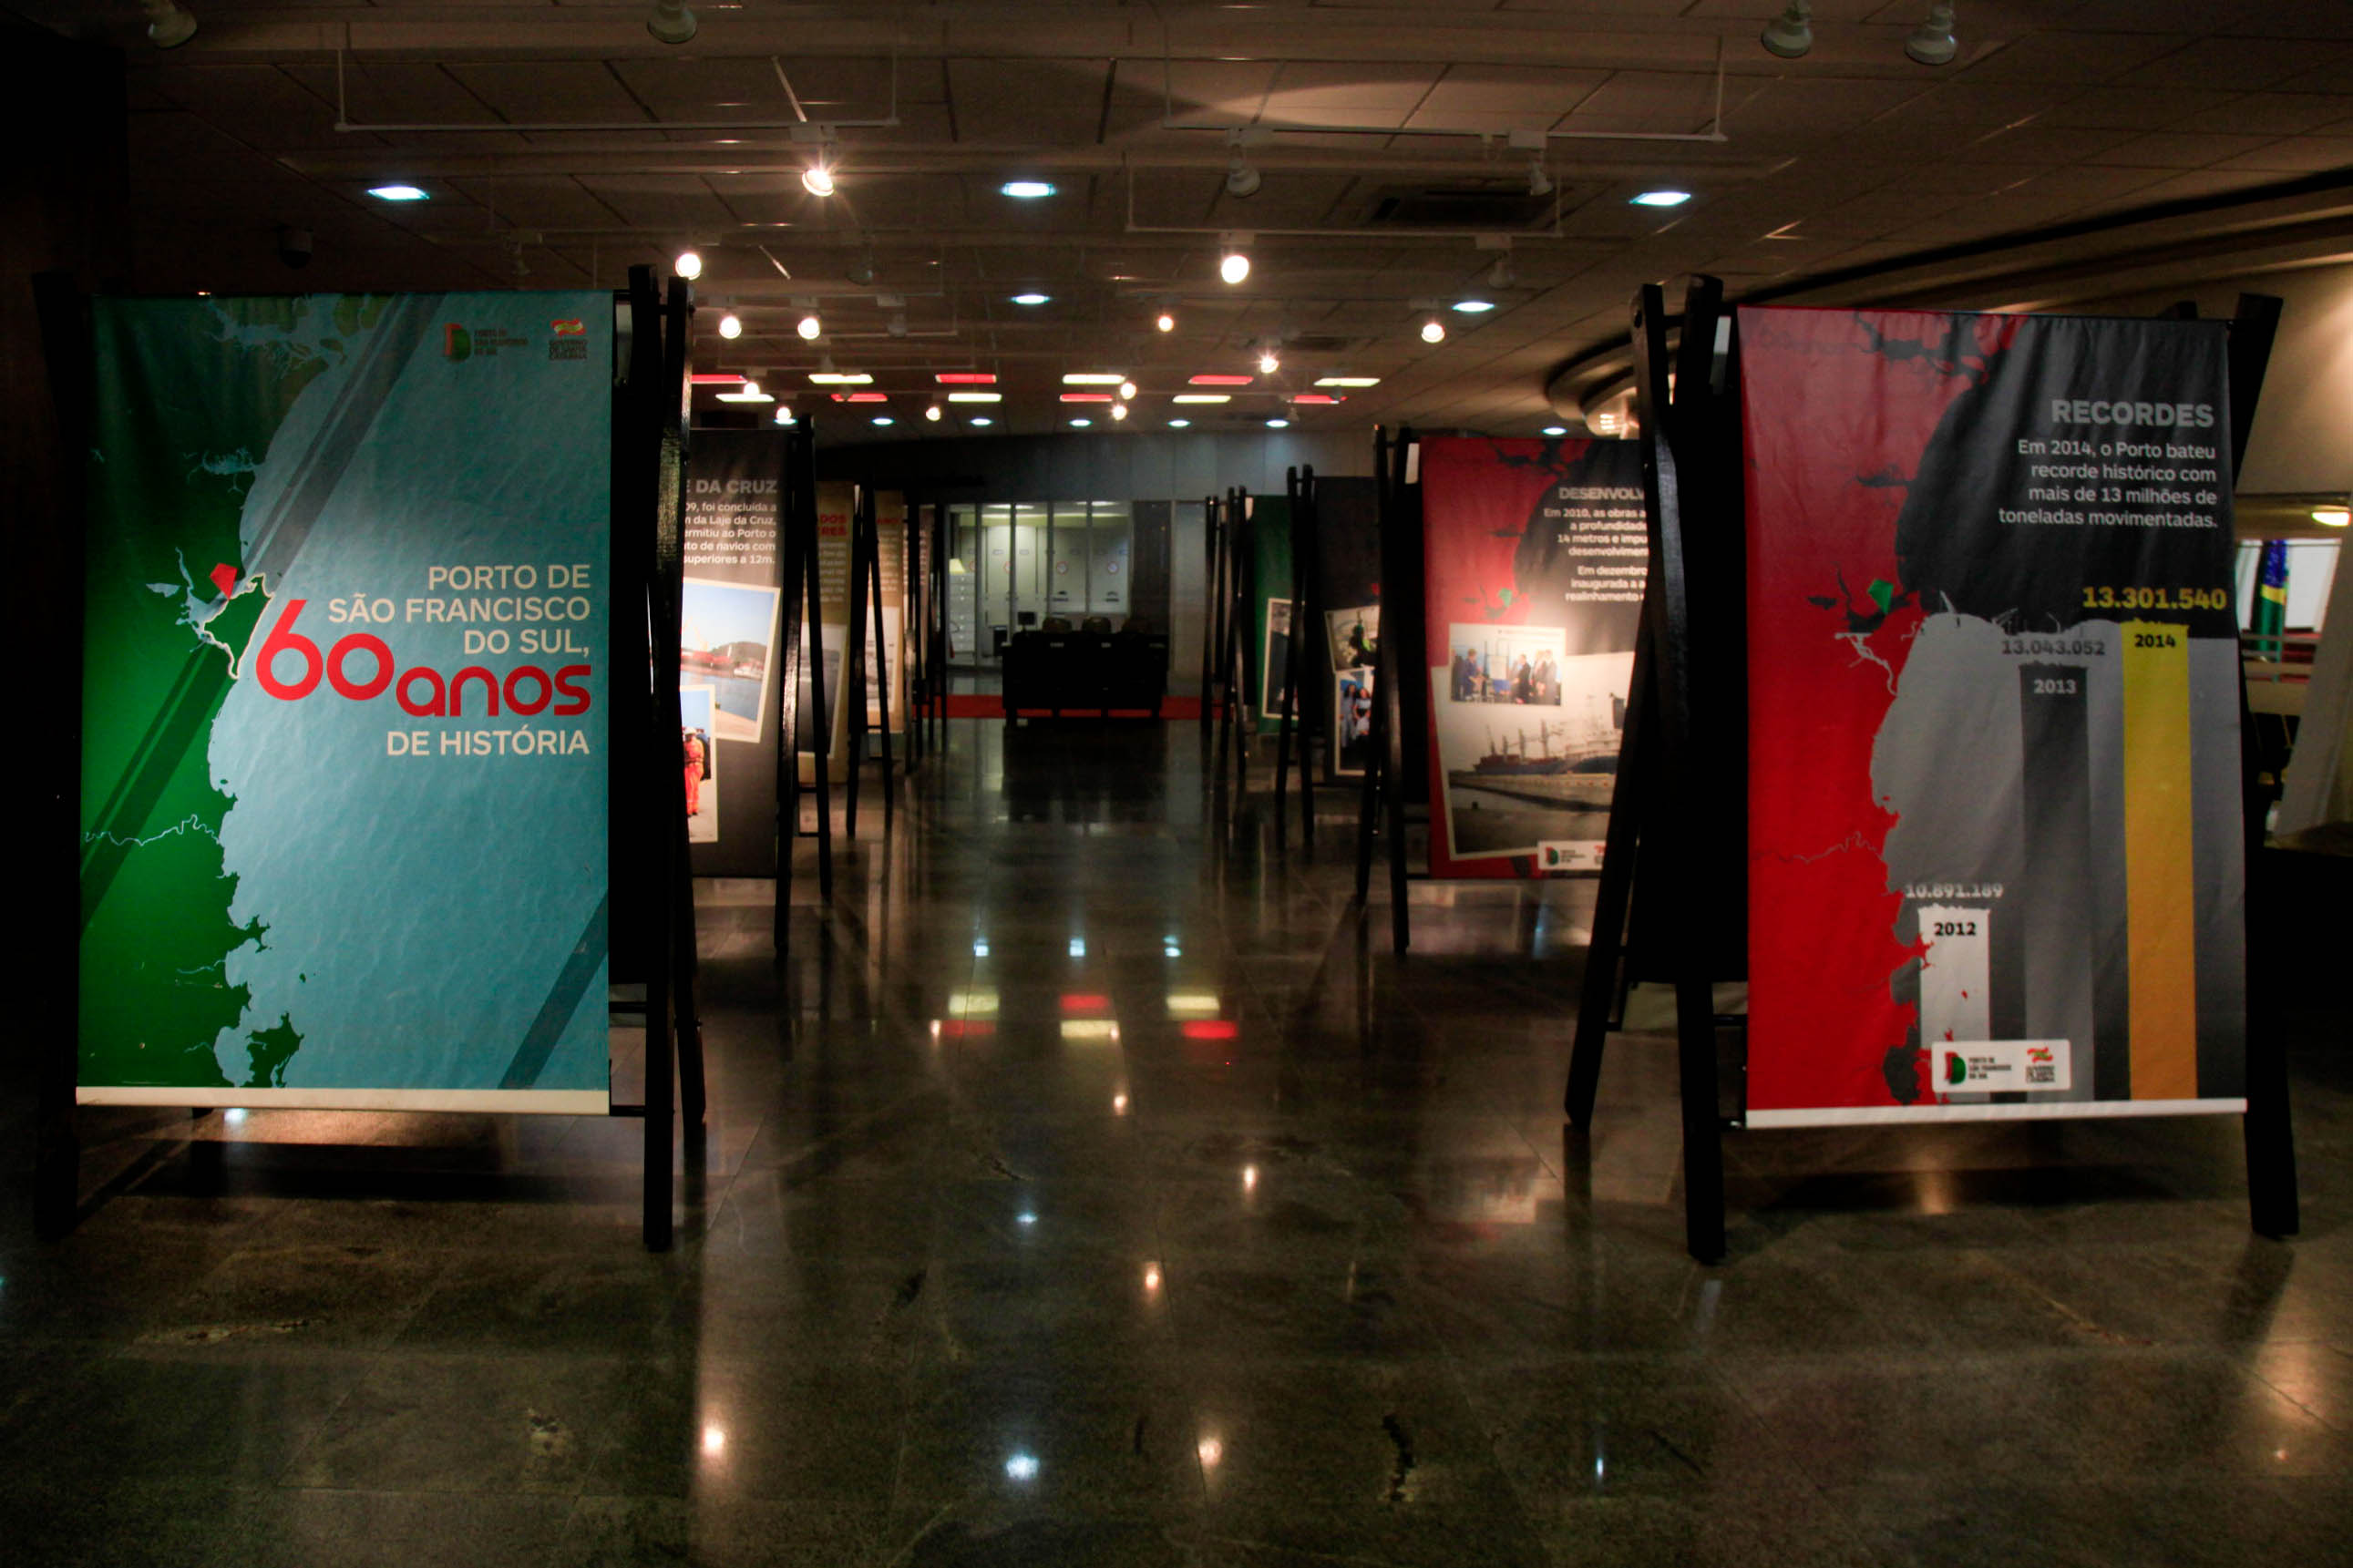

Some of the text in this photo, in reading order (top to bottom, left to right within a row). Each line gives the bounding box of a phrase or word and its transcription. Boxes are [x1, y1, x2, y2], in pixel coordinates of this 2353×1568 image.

[2050, 399, 2215, 428] RECORDES
[2017, 439, 2216, 459] Em 2014, o Porto bateu
[2030, 463, 2217, 482] recorde histórico com
[695, 479, 722, 494] DA
[726, 479, 778, 494] CRUZ
[2029, 486, 2217, 506] mais de 13 milhões de
[702, 502, 715, 512] foi
[717, 502, 768, 512] concluída
[770, 504, 777, 512] a
[1543, 507, 1561, 518] Em
[1593, 508, 1606, 518] as
[1608, 507, 1638, 518] obras
[693, 515, 707, 525] da
[709, 516, 732, 526] Laje
[734, 516, 747, 525] da
[1998, 507, 2219, 528] toneladas movimentadas.
[722, 530, 735, 538] ao
[737, 528, 766, 538] Porto
[768, 530, 776, 538] o
[1569, 522, 1577, 531] a
[700, 541, 714, 551] de
[716, 541, 751, 551] navios
[752, 542, 776, 551] com
[1572, 534, 1610, 544] metros
[1611, 535, 1619, 544] e
[740, 555, 747, 564] a
[749, 554, 776, 564] 12m.
[427, 564, 591, 591] PORTO DE
[1577, 566, 1595, 576] Em
[2081, 586, 2228, 610] 13.301.540
[328, 592, 591, 623] SÃO FRANCISCO
[463, 628, 591, 659] DO SUL,
[2001, 640, 2106, 656] 13.043.052
[2134, 634, 2176, 648] 2014
[2033, 679, 2078, 694] 2013
[386, 723, 591, 756] DE HISTÓRIA
[1934, 922, 1977, 937] 2012
